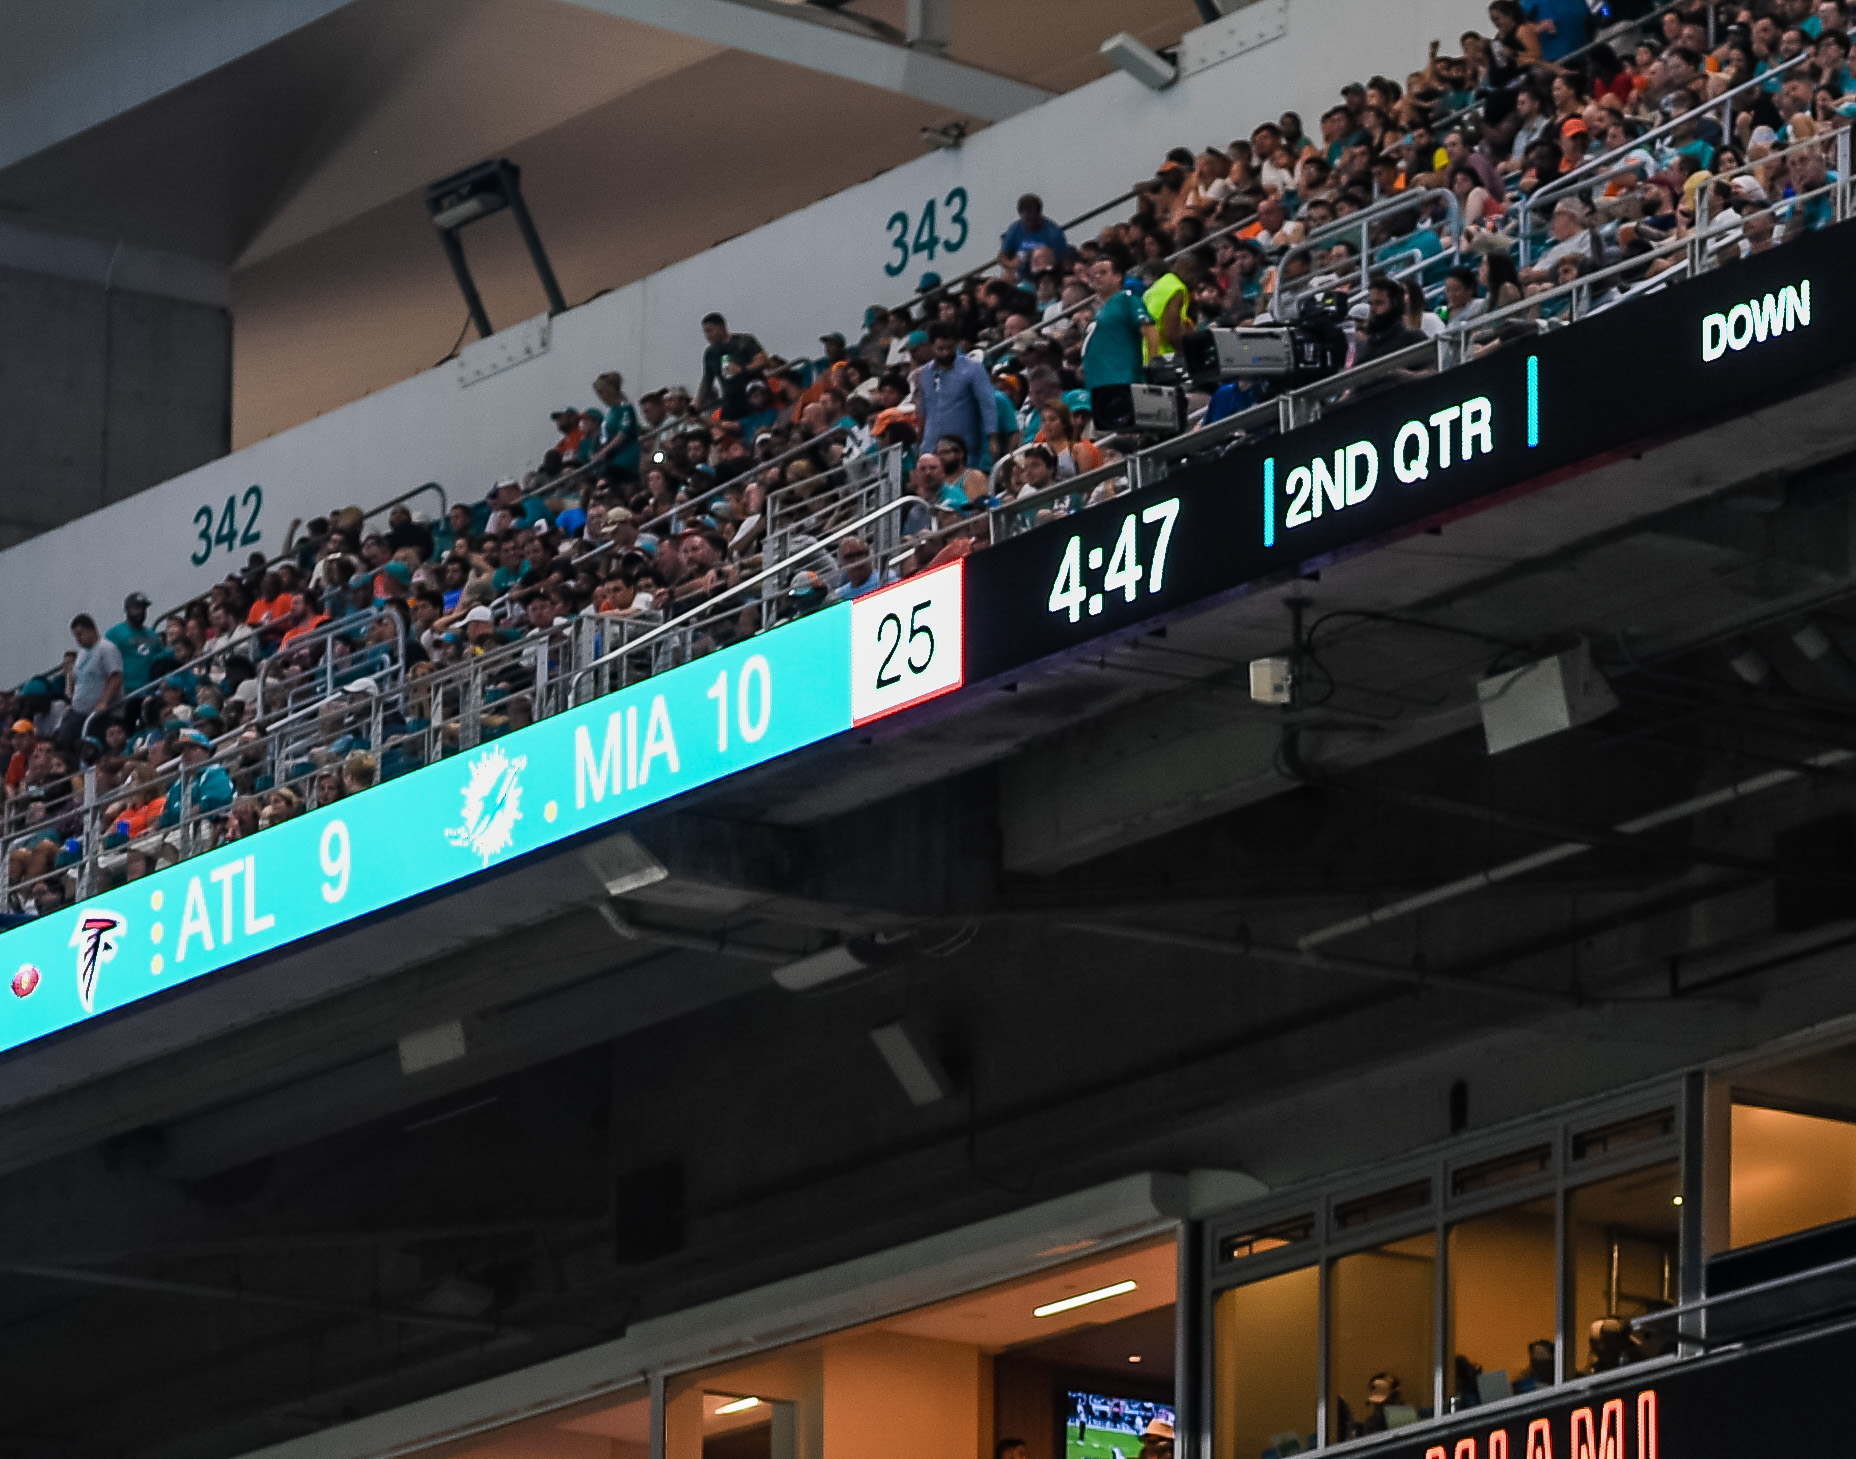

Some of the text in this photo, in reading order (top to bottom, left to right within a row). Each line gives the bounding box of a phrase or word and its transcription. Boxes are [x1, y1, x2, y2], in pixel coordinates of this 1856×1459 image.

[885, 186, 969, 278] 343
[1701, 280, 1812, 363] DOWN
[1285, 396, 1494, 529] 2ND QTR
[191, 484, 263, 567] 342
[1048, 497, 1181, 624] 4:47
[876, 599, 934, 690] 25
[574, 653, 772, 810] MIA 10
[174, 820, 351, 964] ATL 9
